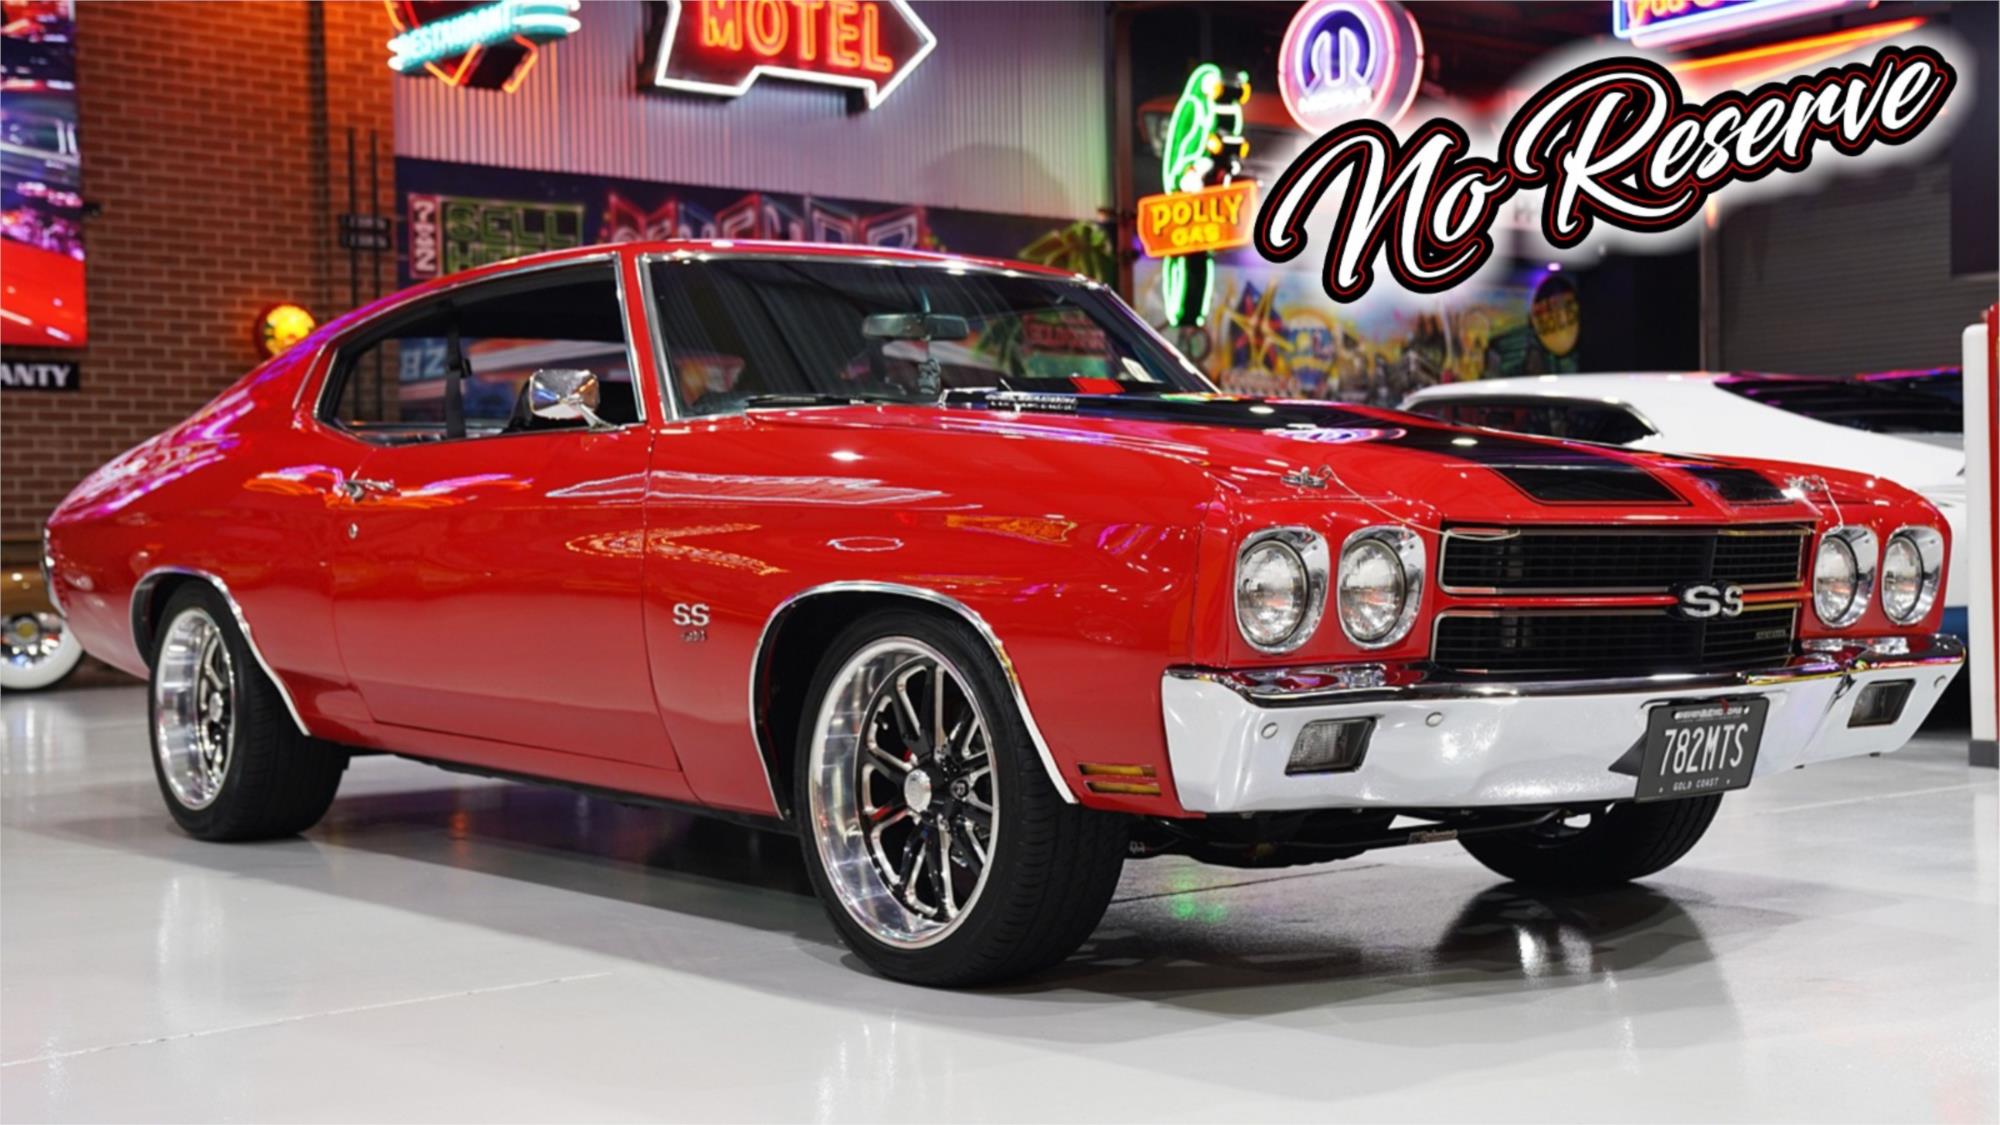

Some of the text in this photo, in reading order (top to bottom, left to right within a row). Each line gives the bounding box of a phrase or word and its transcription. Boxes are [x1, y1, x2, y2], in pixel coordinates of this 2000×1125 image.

[701, 2, 893, 74] MOTEL
[1150, 193, 1243, 236] POLLY
[1171, 222, 1220, 247] GAS
[672, 603, 710, 627] SS
[1682, 585, 1744, 618] SS
[1660, 722, 1749, 776] 782MTS
[1673, 777, 1720, 792] GOLD COAST
